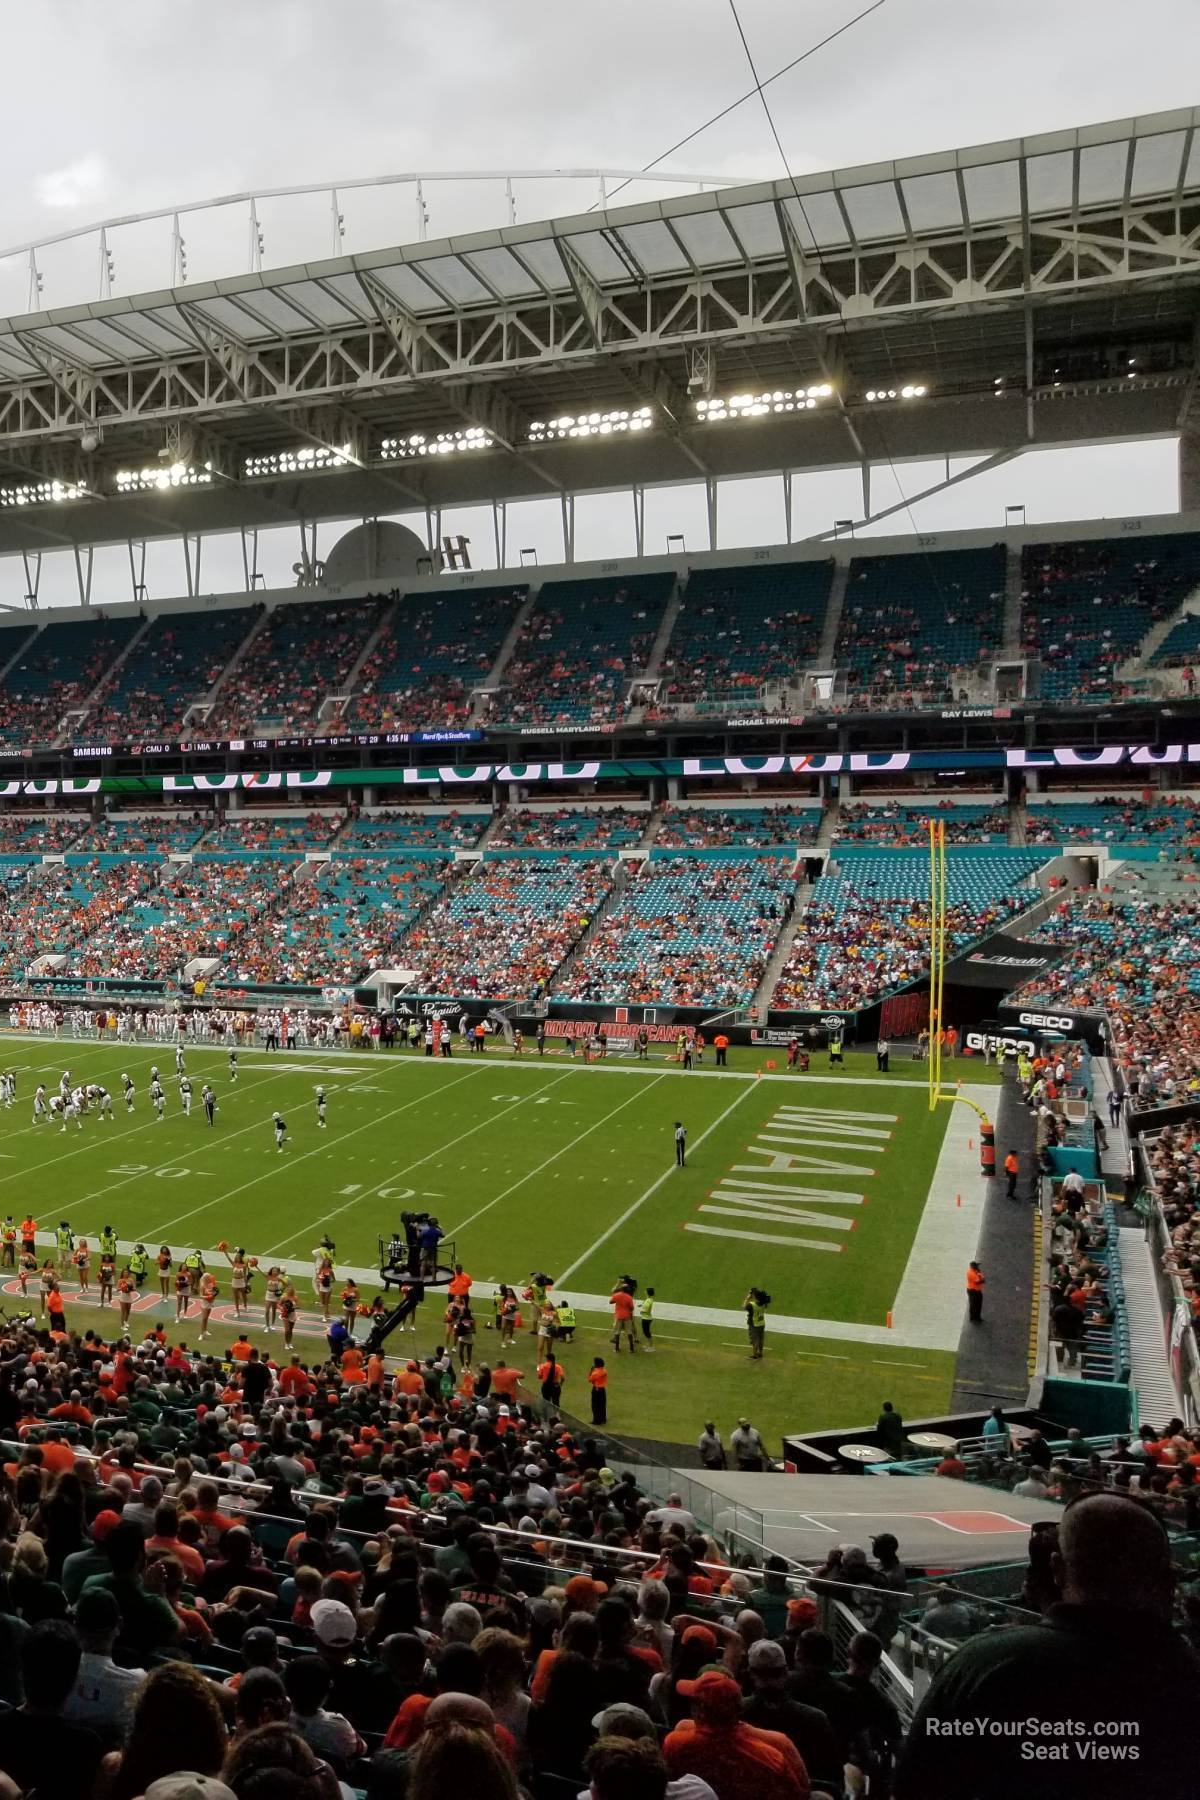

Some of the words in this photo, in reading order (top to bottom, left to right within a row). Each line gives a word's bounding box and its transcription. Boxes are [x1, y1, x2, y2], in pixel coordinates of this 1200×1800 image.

[941, 710, 962, 718] RAY
[963, 709, 993, 718] LEWIS
[727, 718, 764, 726] MICHAEL
[765, 717, 789, 725] IRVIN
[521, 726, 555, 735] RUSSELL
[555, 725, 601, 734] MARYLAND
[145, 745, 162, 753] CMU
[197, 743, 211, 751] MIA
[216, 742, 221, 750] 7
[73, 747, 112, 757] SAMSUNG
[1019, 1013, 1073, 1030] GEICO
[544, 1021, 597, 1038] MIAMI
[459, 1589, 506, 1612] MIAMI
